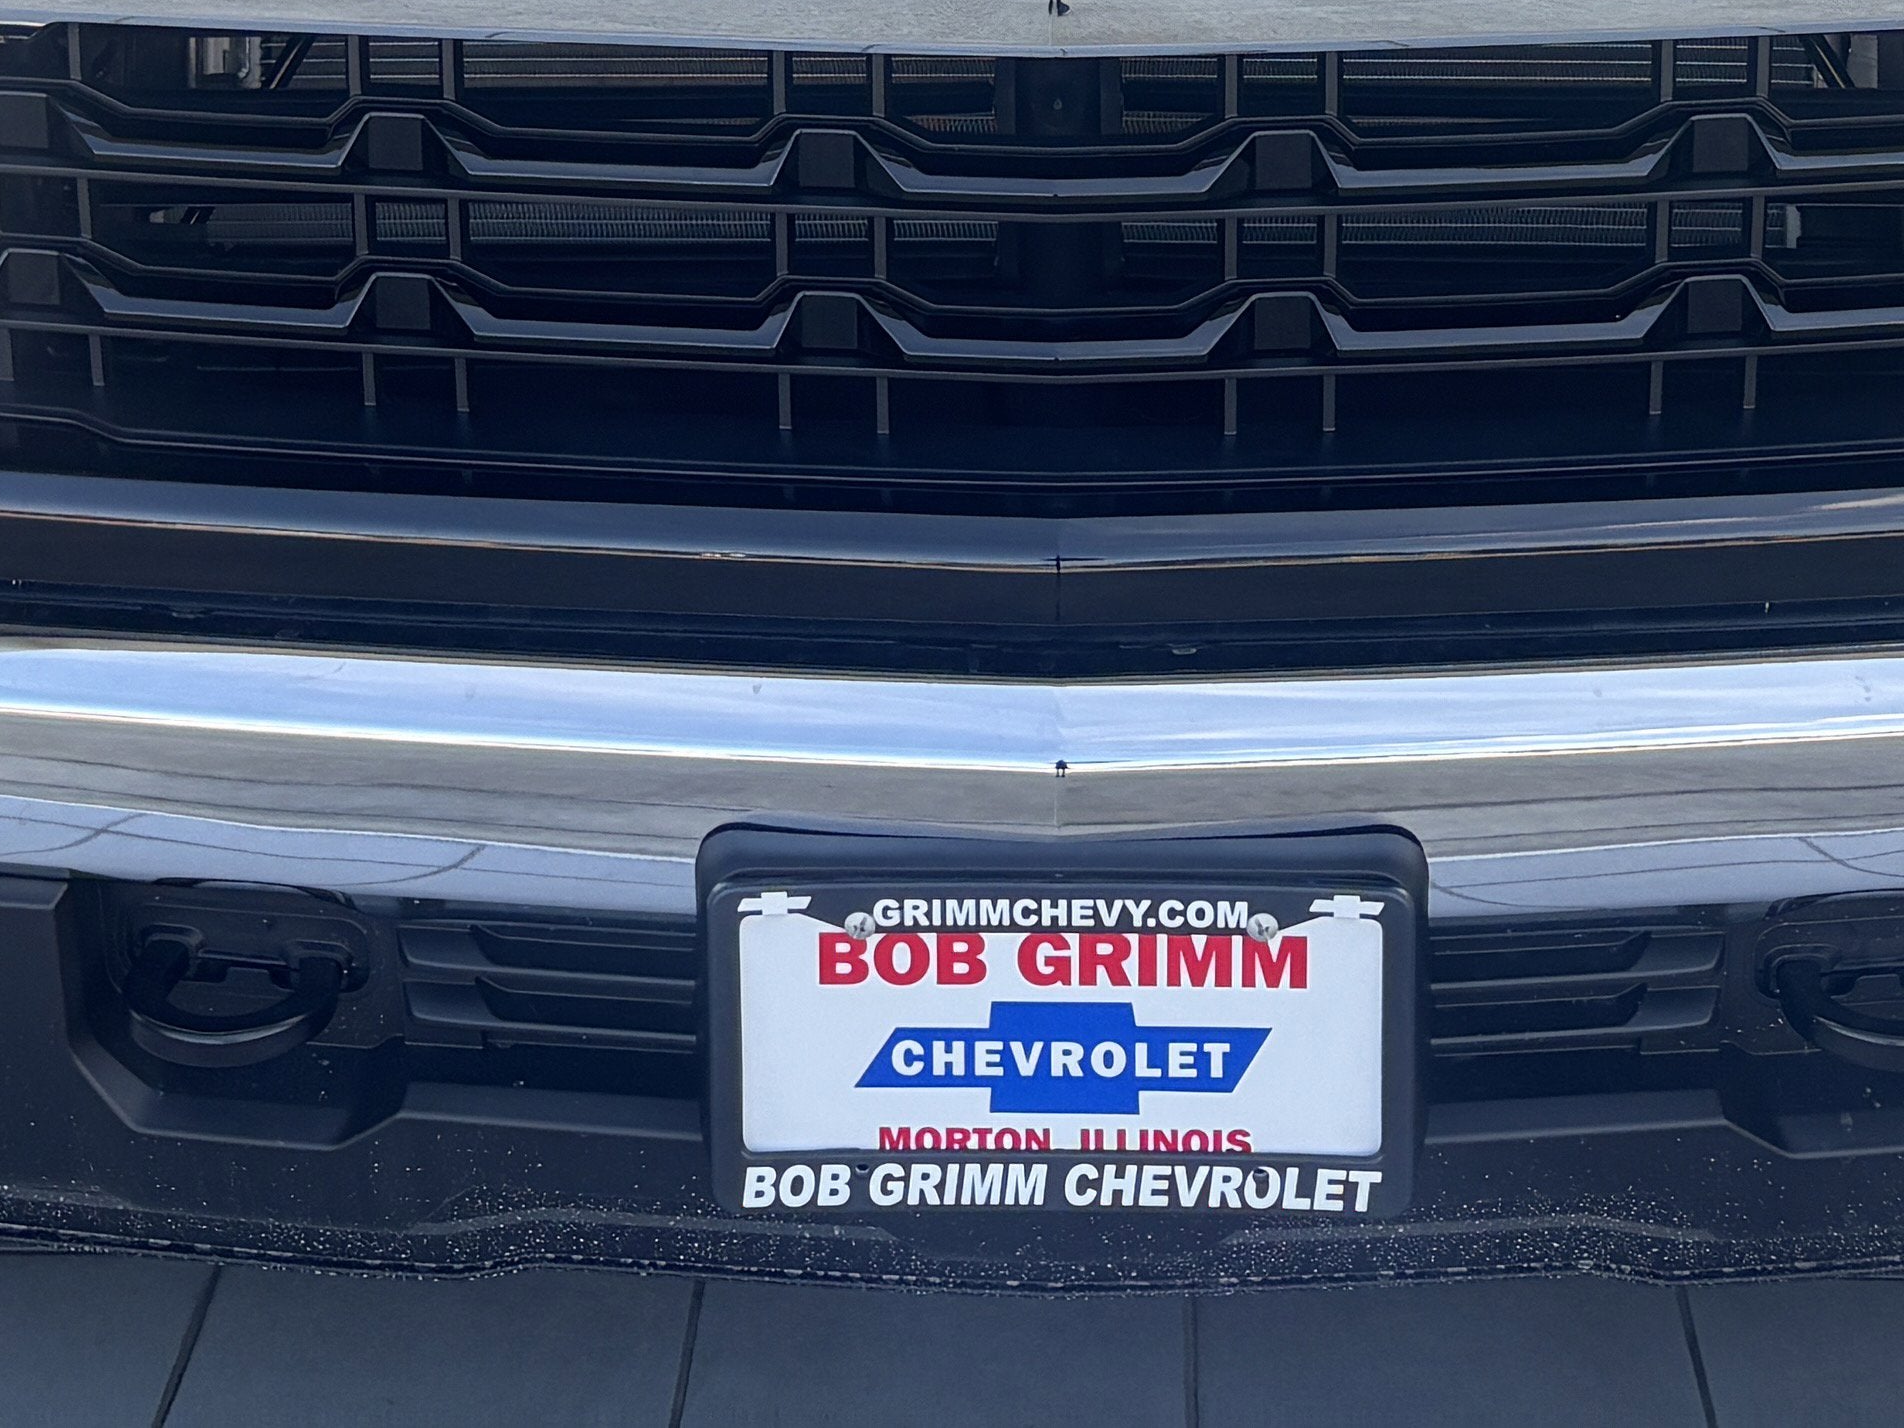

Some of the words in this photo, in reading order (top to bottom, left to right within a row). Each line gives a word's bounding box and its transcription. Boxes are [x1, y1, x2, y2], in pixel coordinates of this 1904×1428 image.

[872, 898, 1248, 929] GRIMMCHEVY.COM
[818, 932, 988, 986] BOB
[1016, 932, 1308, 989] GRIMM
[891, 1039, 1231, 1079] CHEVROLET
[742, 1163, 852, 1208] BOB
[868, 1163, 1048, 1206] GRIMM
[1064, 1163, 1382, 1212] CHEVROLET
